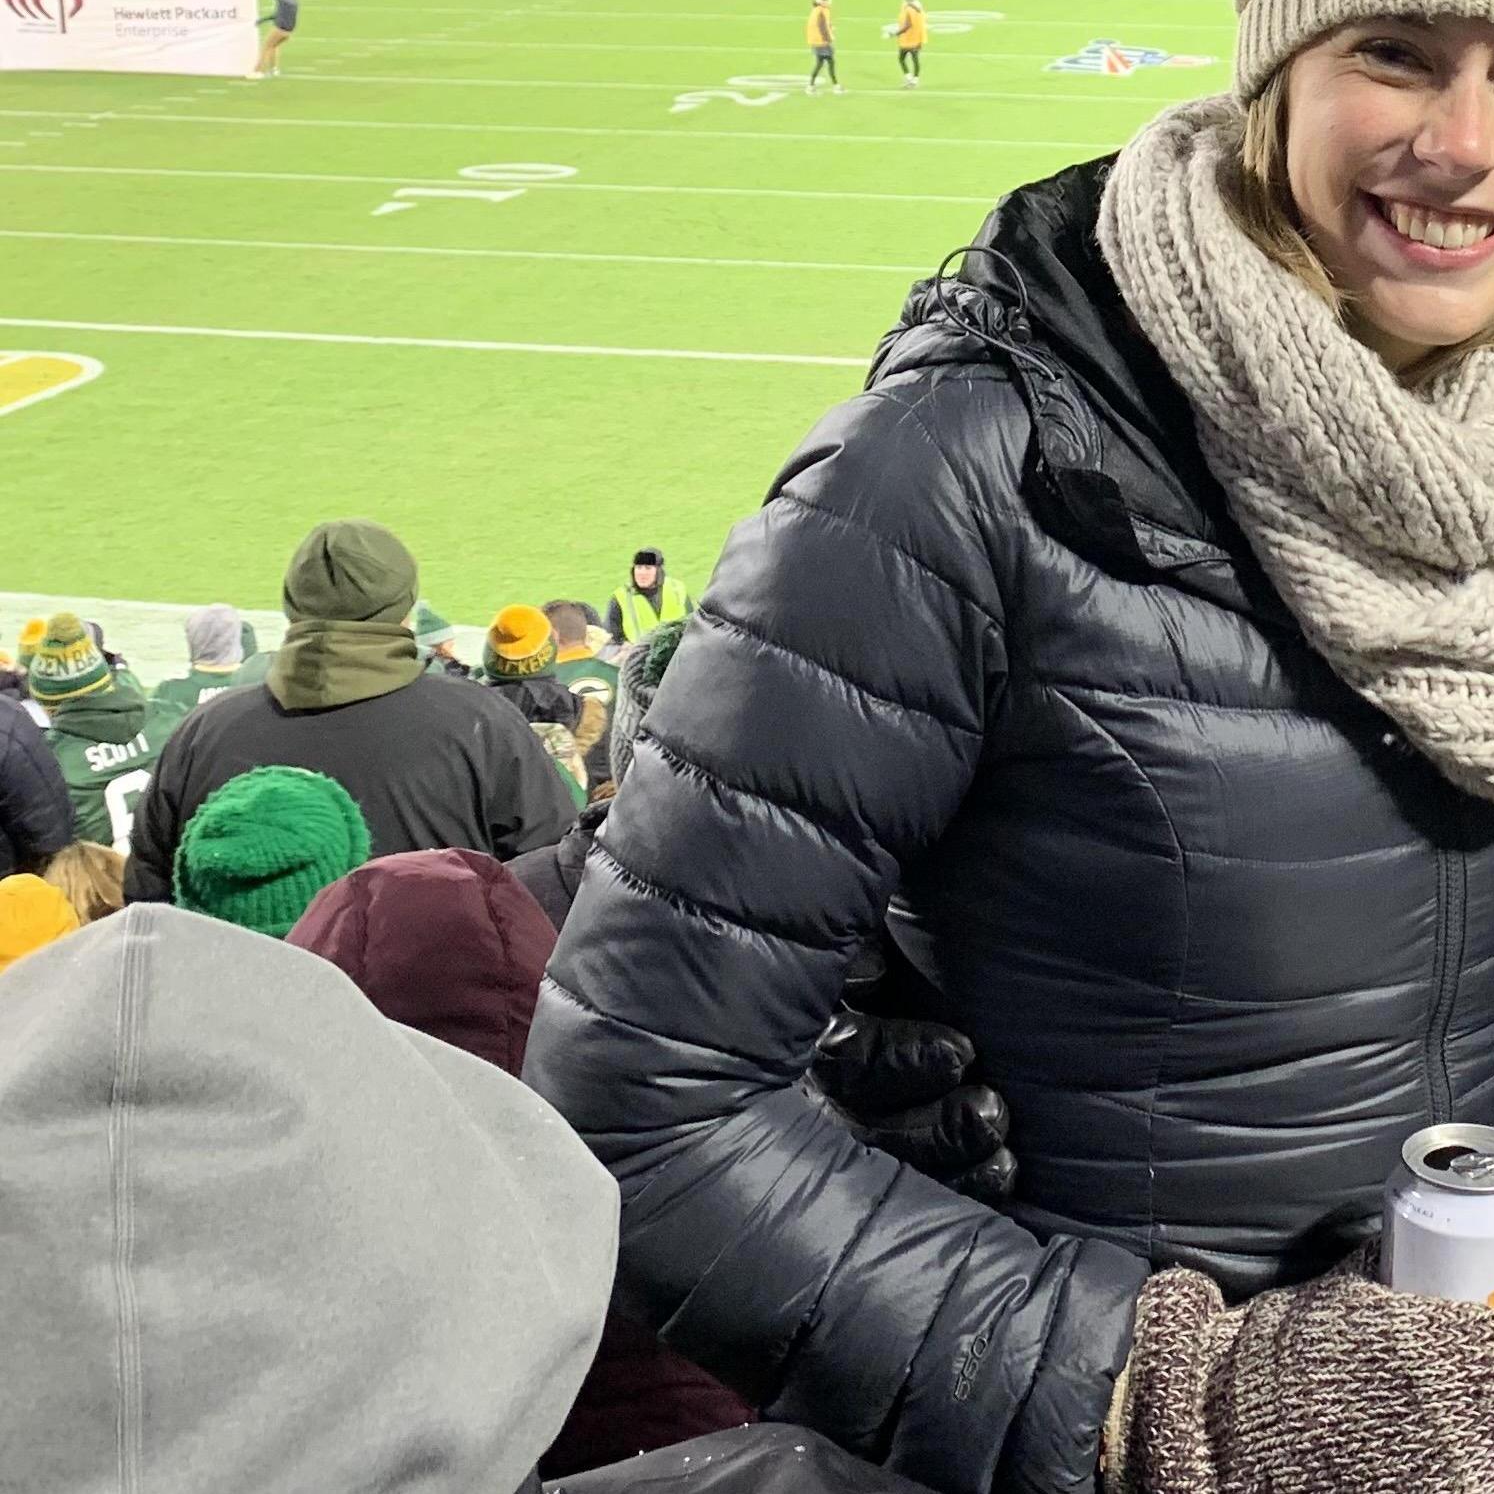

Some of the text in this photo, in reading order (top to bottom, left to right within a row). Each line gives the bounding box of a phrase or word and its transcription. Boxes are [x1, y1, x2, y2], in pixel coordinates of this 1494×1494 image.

[113, 7, 238, 21] Hewlett Packard
[115, 24, 189, 38] Enterprise
